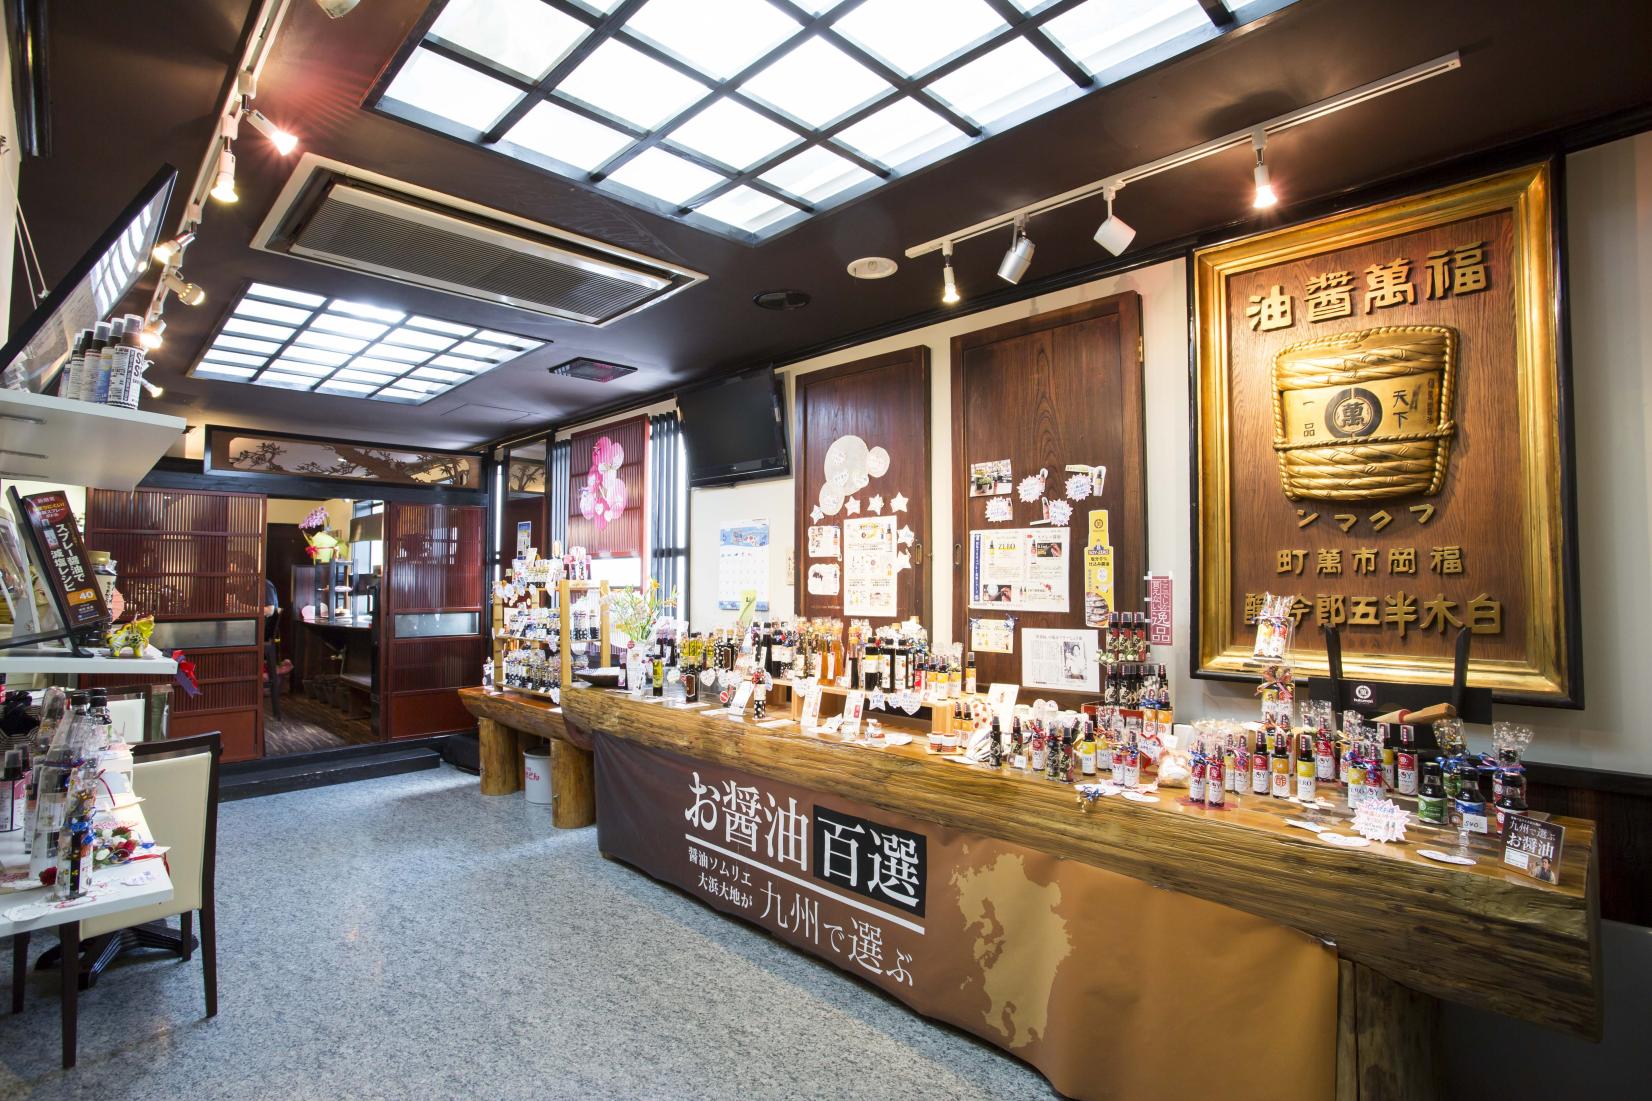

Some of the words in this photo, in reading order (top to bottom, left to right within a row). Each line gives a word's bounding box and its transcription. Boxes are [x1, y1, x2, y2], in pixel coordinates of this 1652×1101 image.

[1303, 400, 1315, 437] 一品
[1393, 389, 1409, 429] 天下
[1152, 611, 1170, 642] 逸品
[684, 771, 920, 908] お醤油百選
[1507, 832, 1554, 859] お醤油
[1509, 819, 1556, 841] 九州で選ぶ
[688, 846, 753, 887] 醤油ソムリエ
[697, 871, 753, 909] 大浜大地が
[759, 880, 914, 987] 九州で選ぶ
